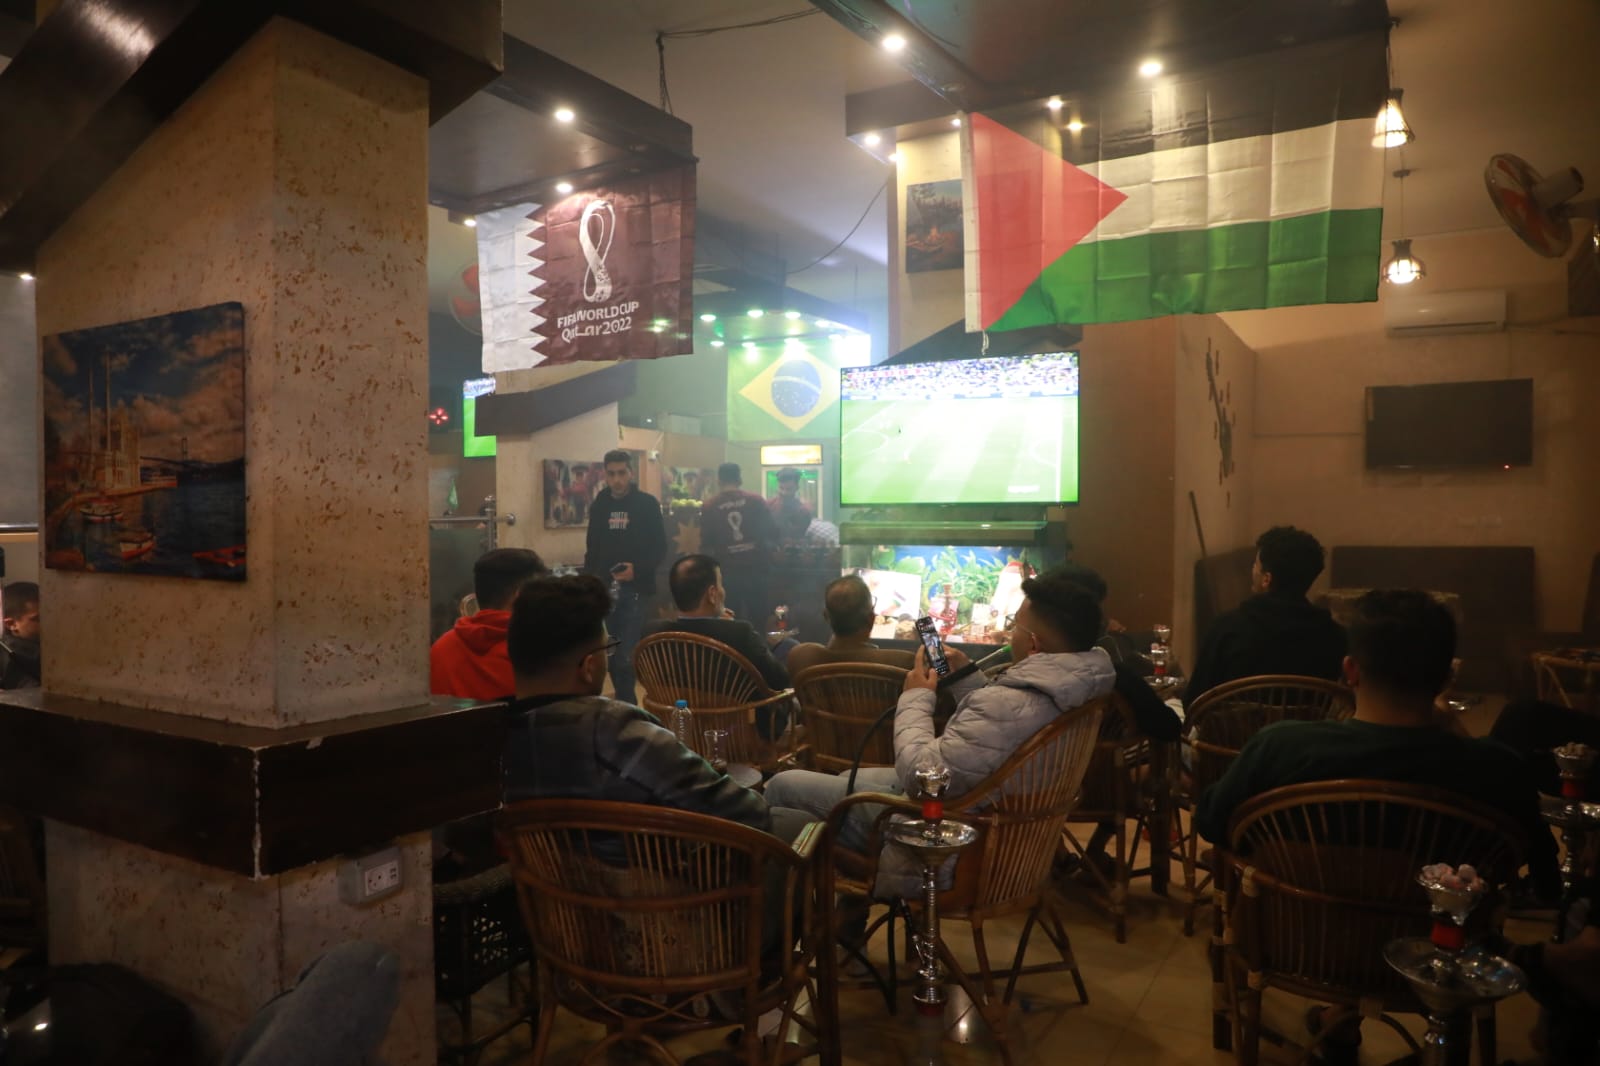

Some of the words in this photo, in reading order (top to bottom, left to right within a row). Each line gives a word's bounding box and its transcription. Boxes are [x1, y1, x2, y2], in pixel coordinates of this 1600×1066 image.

[557, 313, 577, 329] FIFA
[577, 306, 619, 321] WORLD
[619, 301, 640, 315] CUP
[602, 316, 632, 335] 2022
